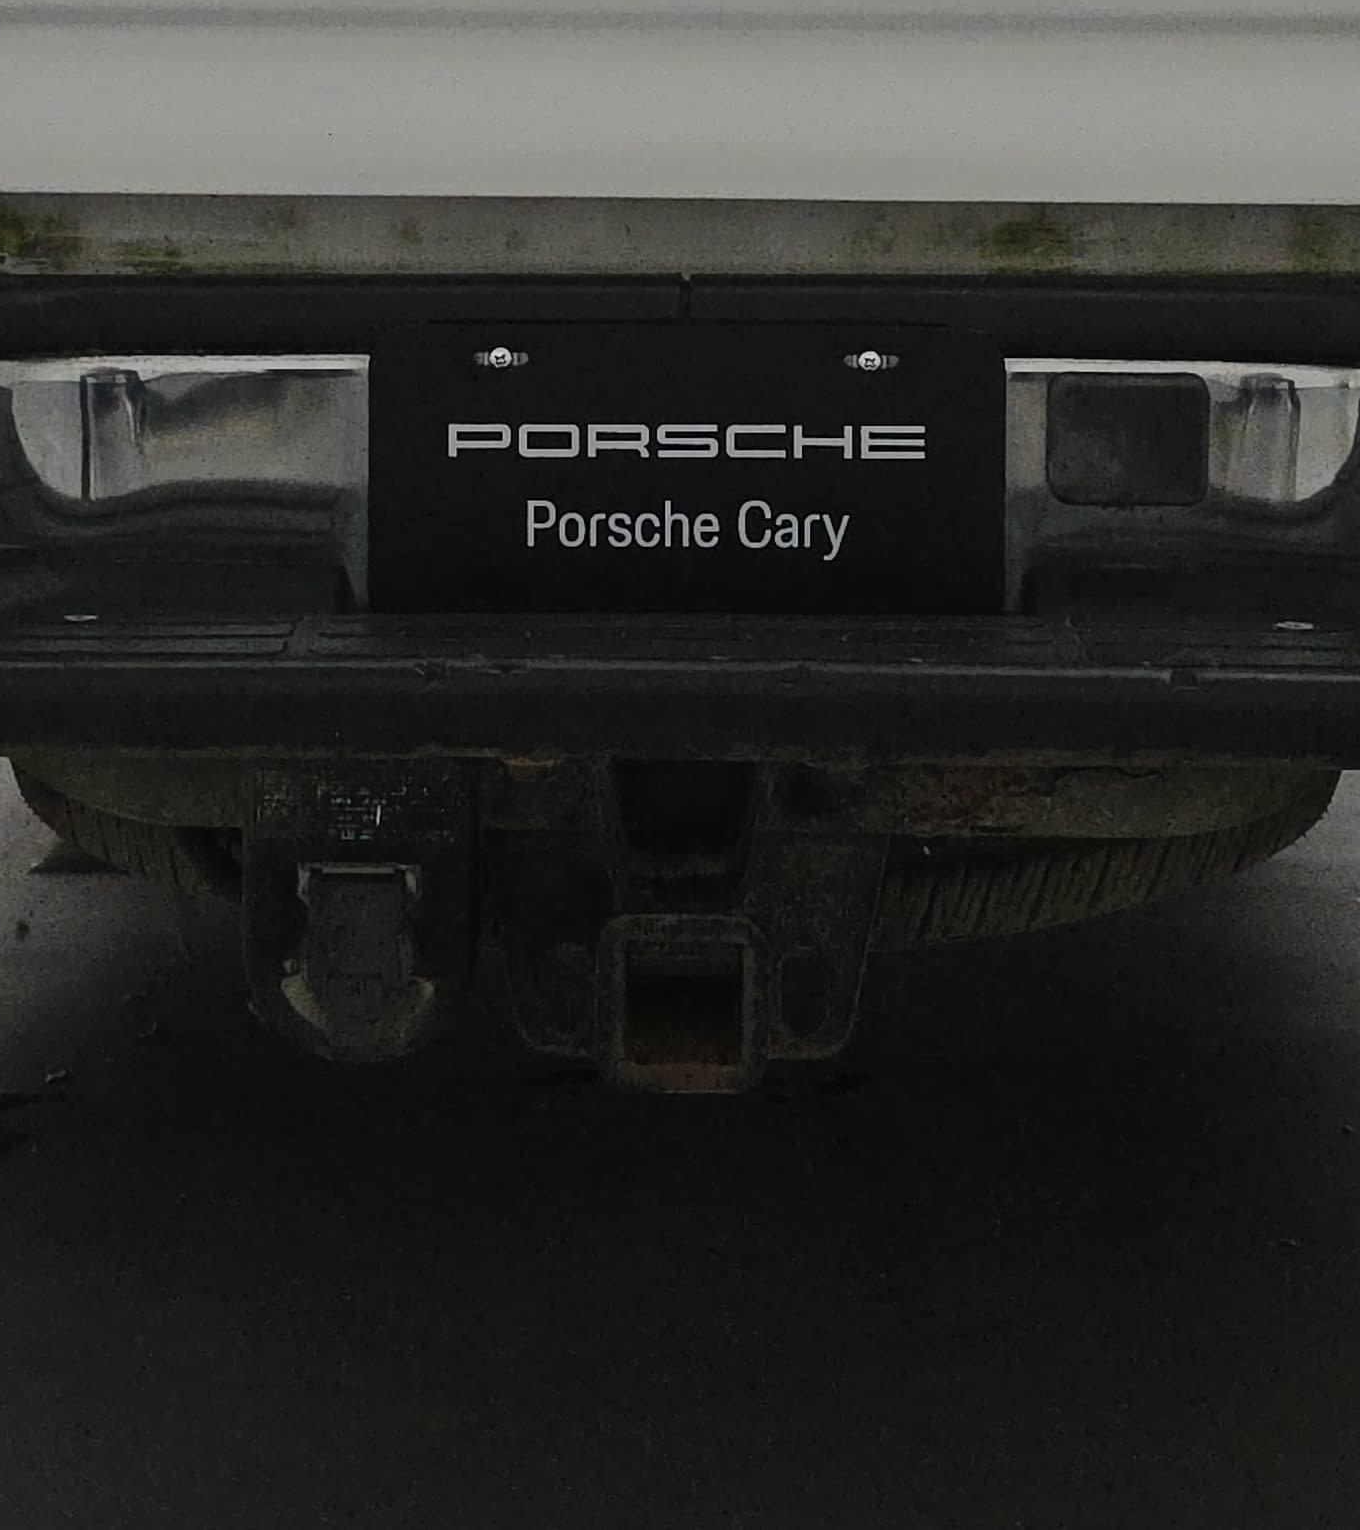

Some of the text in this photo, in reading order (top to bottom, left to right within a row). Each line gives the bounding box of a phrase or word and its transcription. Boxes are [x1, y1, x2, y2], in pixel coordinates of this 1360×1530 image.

[447, 422, 927, 460] PORSCHE
[525, 500, 850, 562] Porsche Cary
